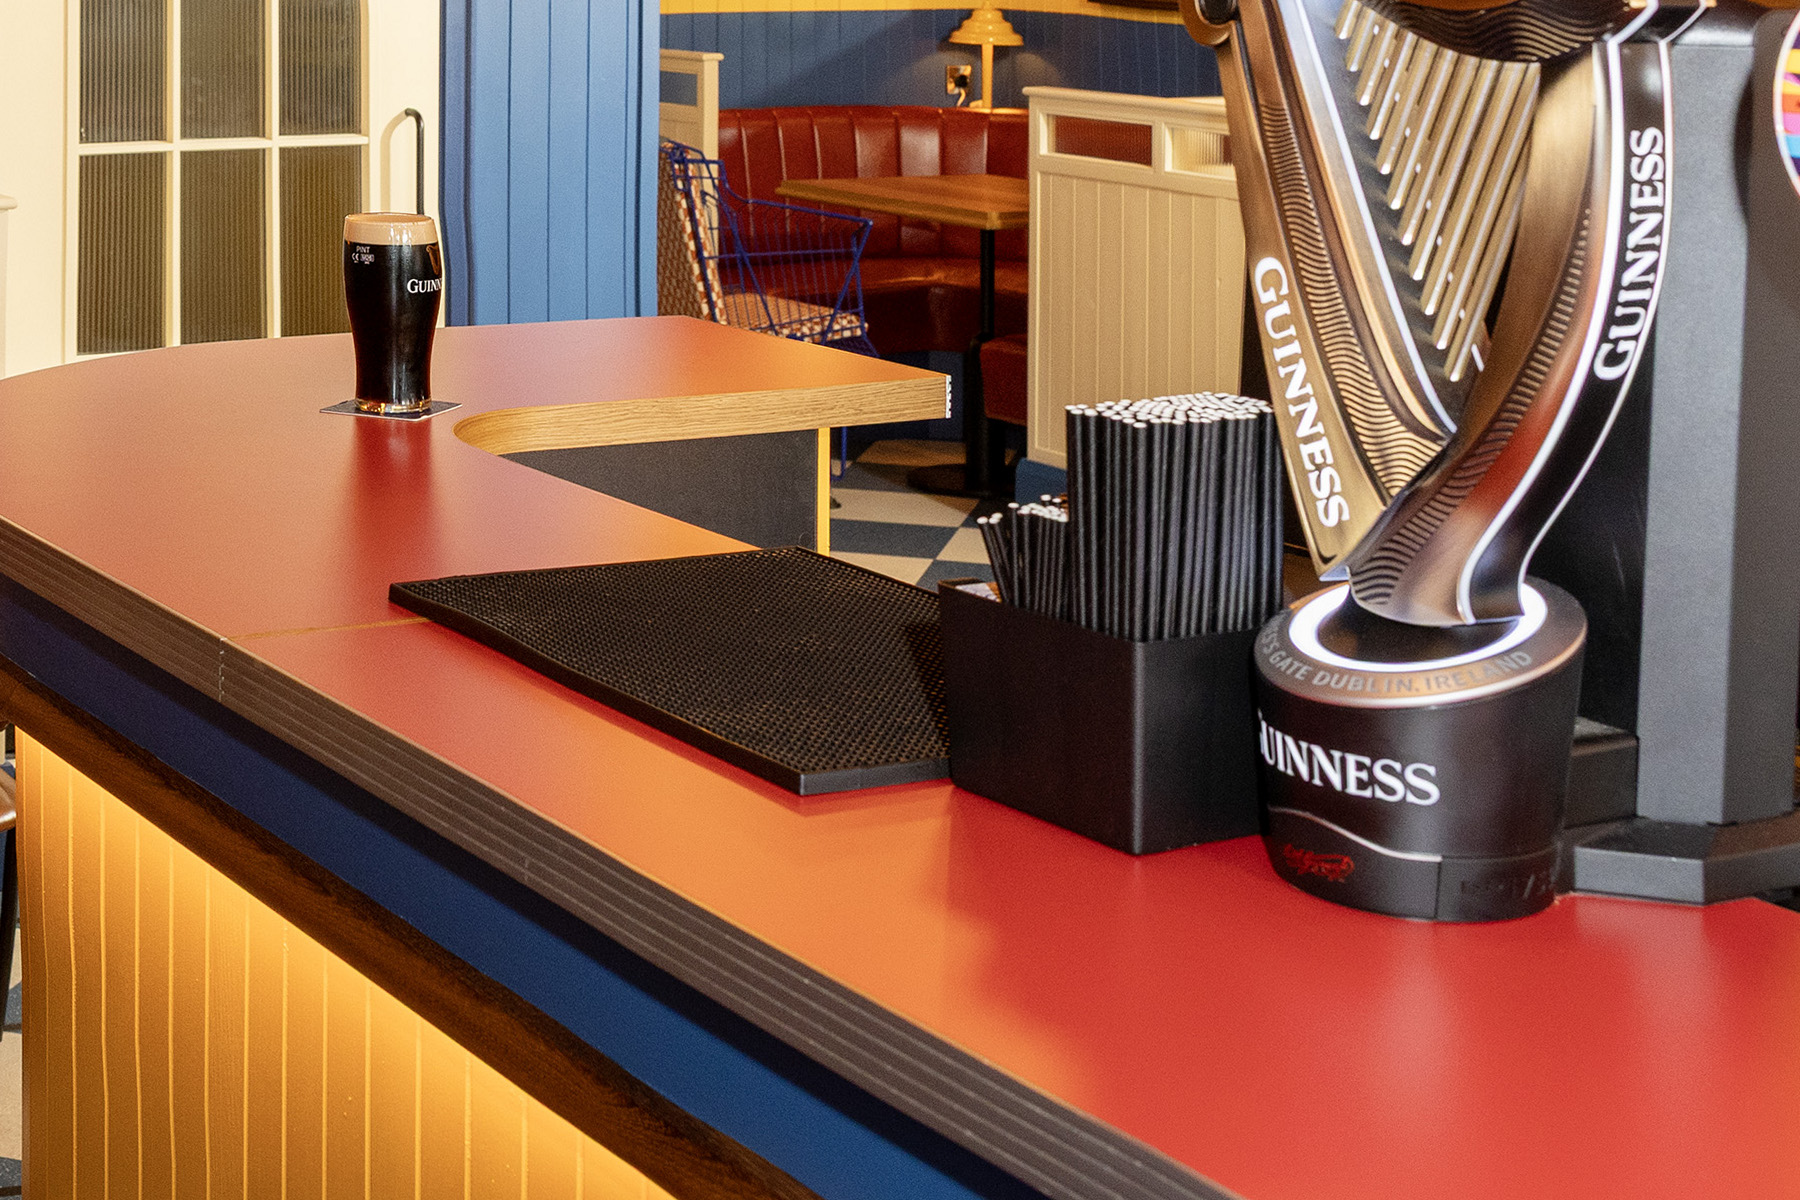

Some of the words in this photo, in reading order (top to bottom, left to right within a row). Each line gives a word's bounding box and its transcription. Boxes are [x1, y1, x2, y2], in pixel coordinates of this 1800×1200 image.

[356, 246, 370, 254] PINT
[1594, 126, 1664, 380] GUINNESS
[406, 278, 442, 294] GUINN
[1254, 256, 1350, 528] GUINNESS
[1269, 650, 1312, 681] GATE
[1426, 650, 1533, 691] IRELAND
[1258, 708, 1441, 806] UINNESS
